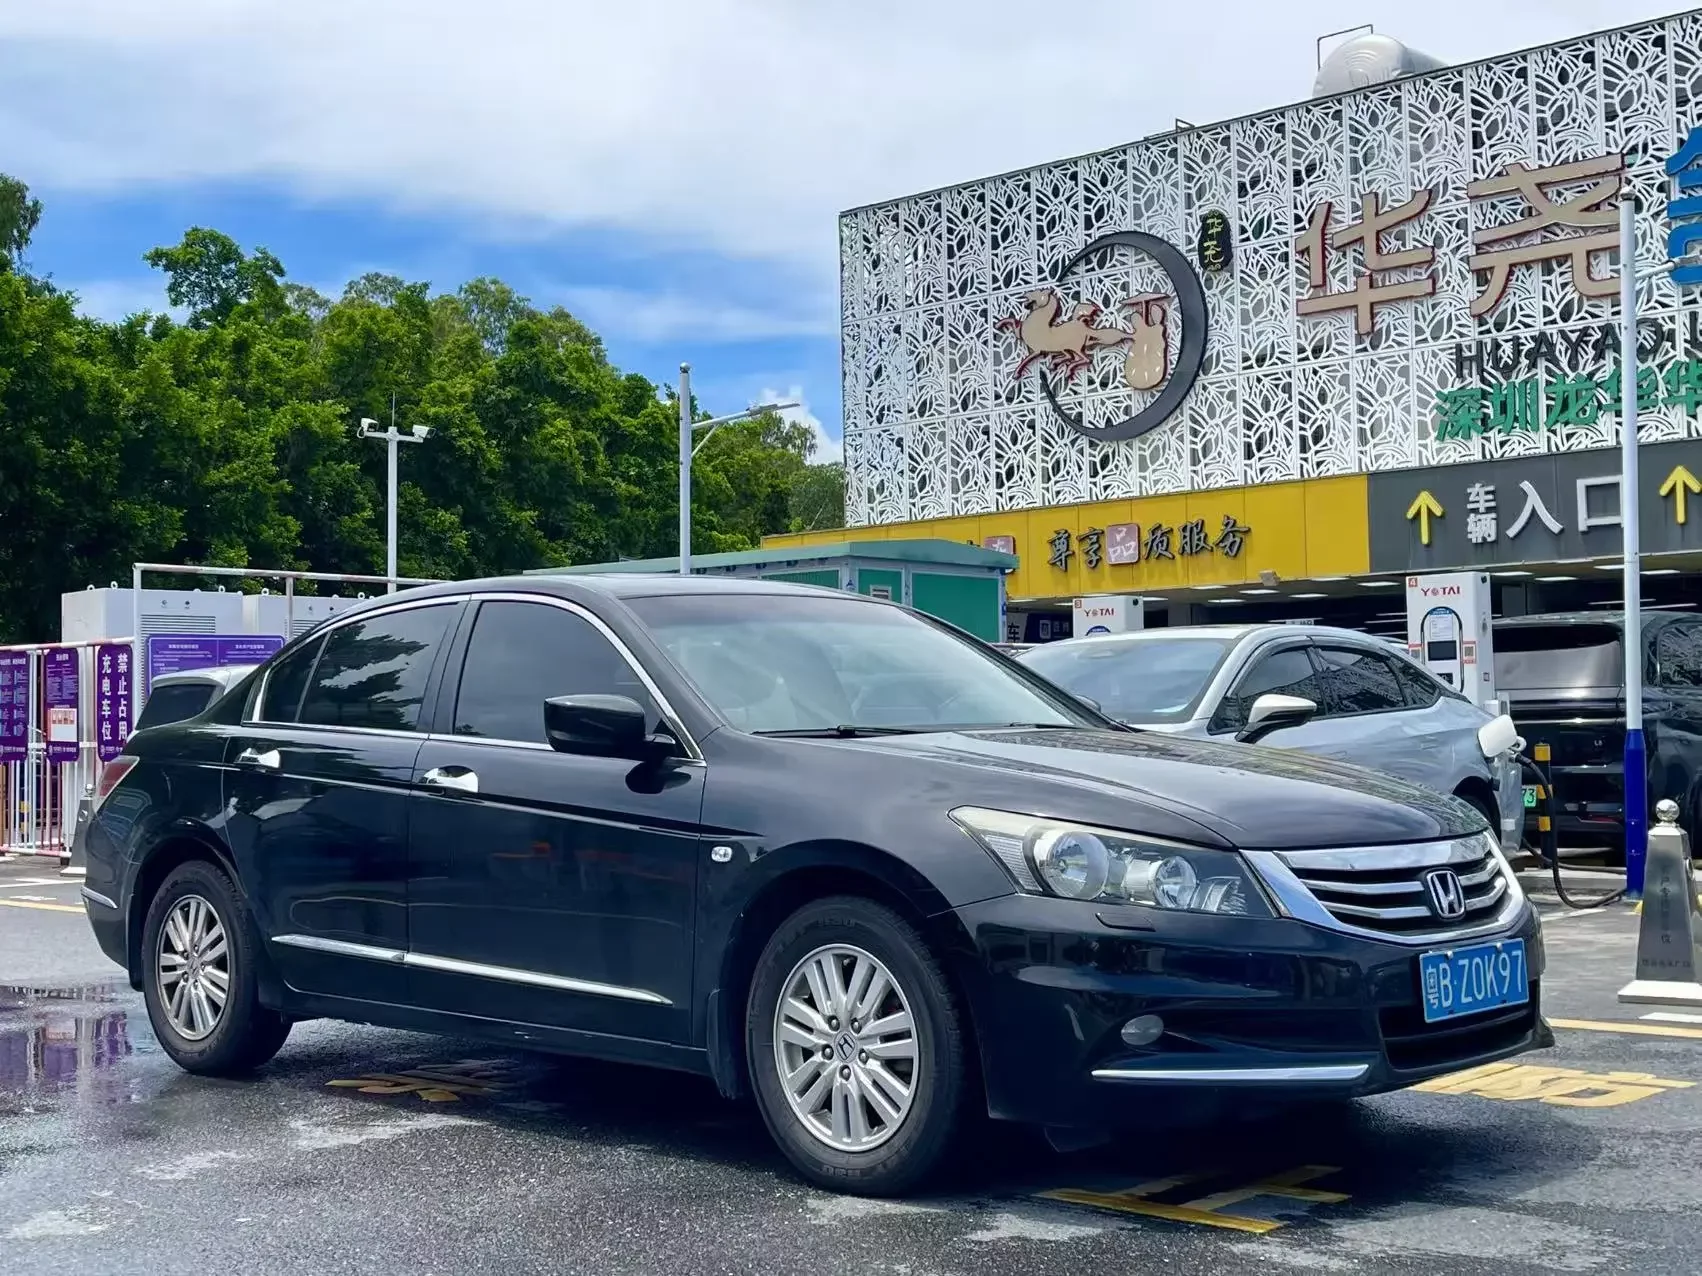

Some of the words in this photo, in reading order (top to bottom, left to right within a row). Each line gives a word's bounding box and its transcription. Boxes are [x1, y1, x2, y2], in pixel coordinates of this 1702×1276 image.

[1047, 515, 1250, 572] 尊享品质服务
[102, 654, 112, 741] 充电车位
